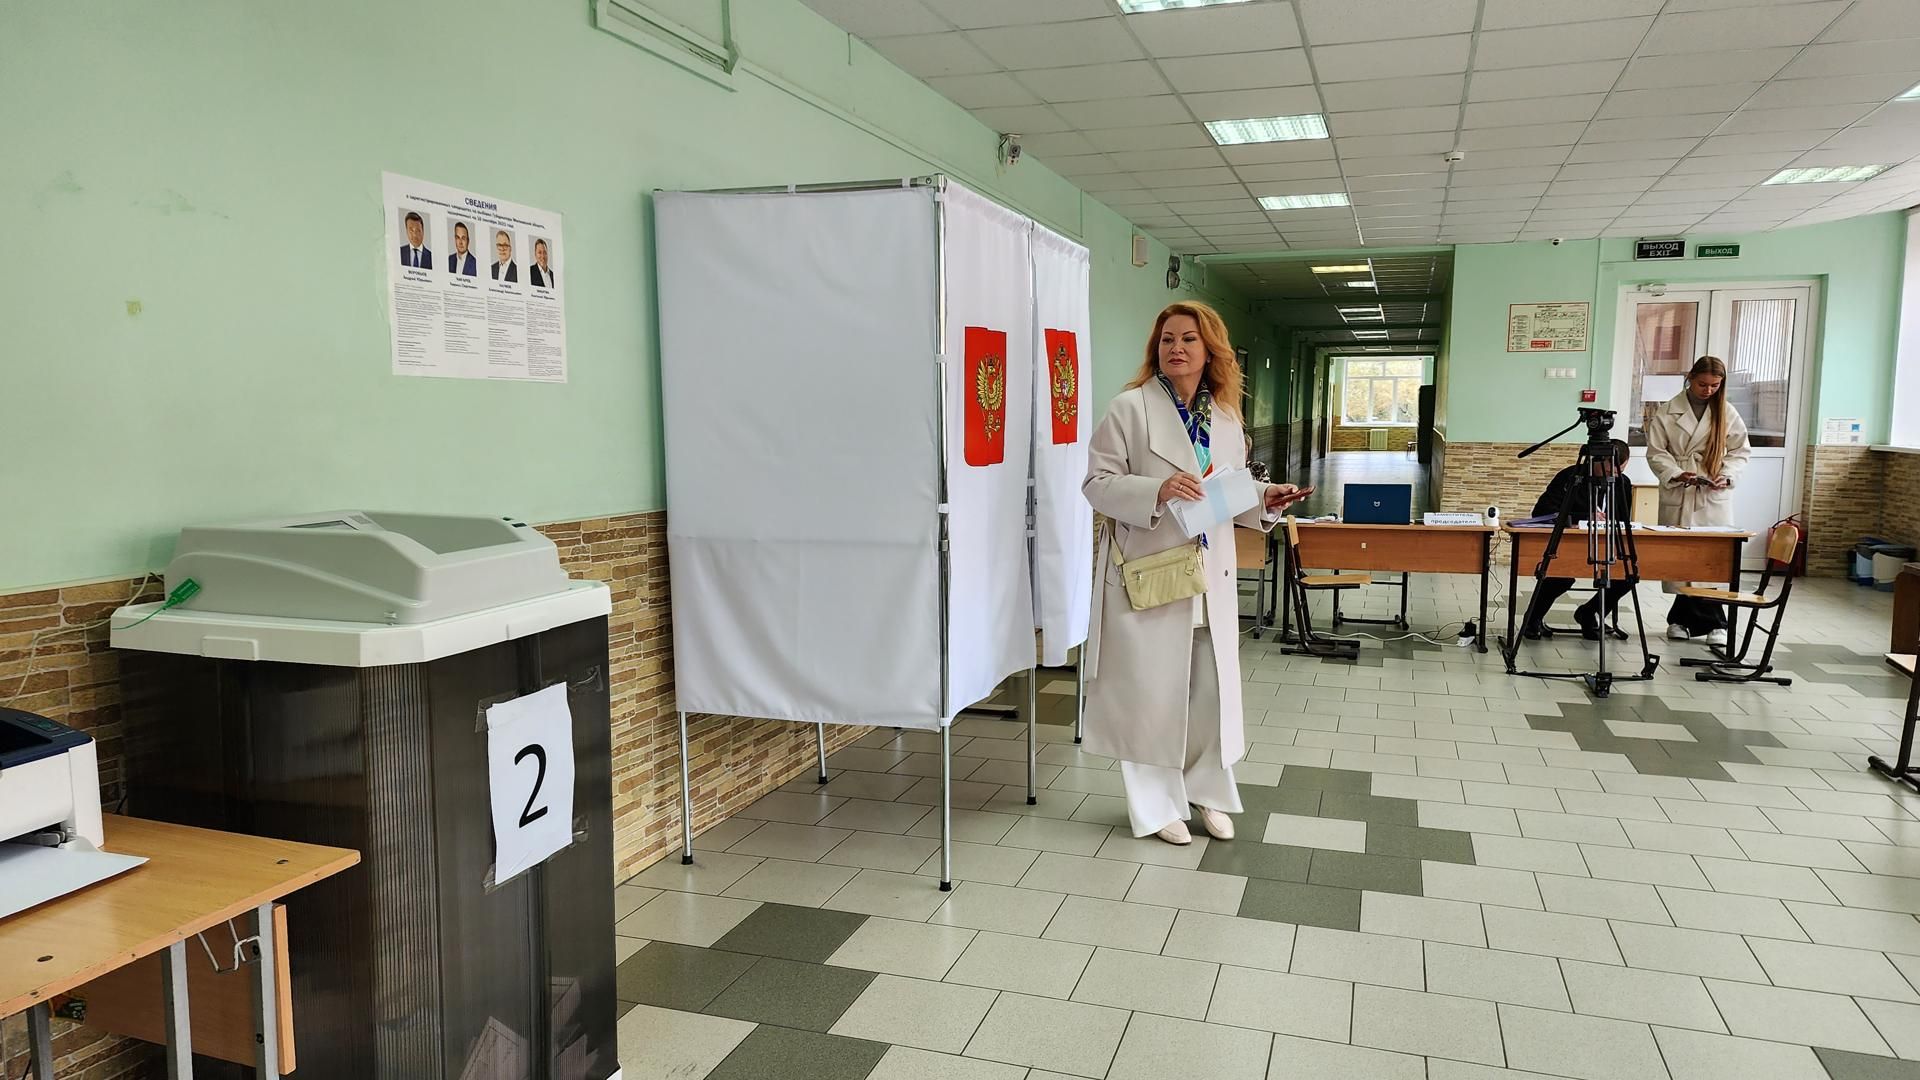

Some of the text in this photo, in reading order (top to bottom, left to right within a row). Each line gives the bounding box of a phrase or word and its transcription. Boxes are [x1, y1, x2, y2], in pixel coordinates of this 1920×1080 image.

[464, 197, 498, 211] СВЕДЕНИЯ
[1704, 247, 1733, 255] ВЫХОД
[514, 743, 548, 829] 2
